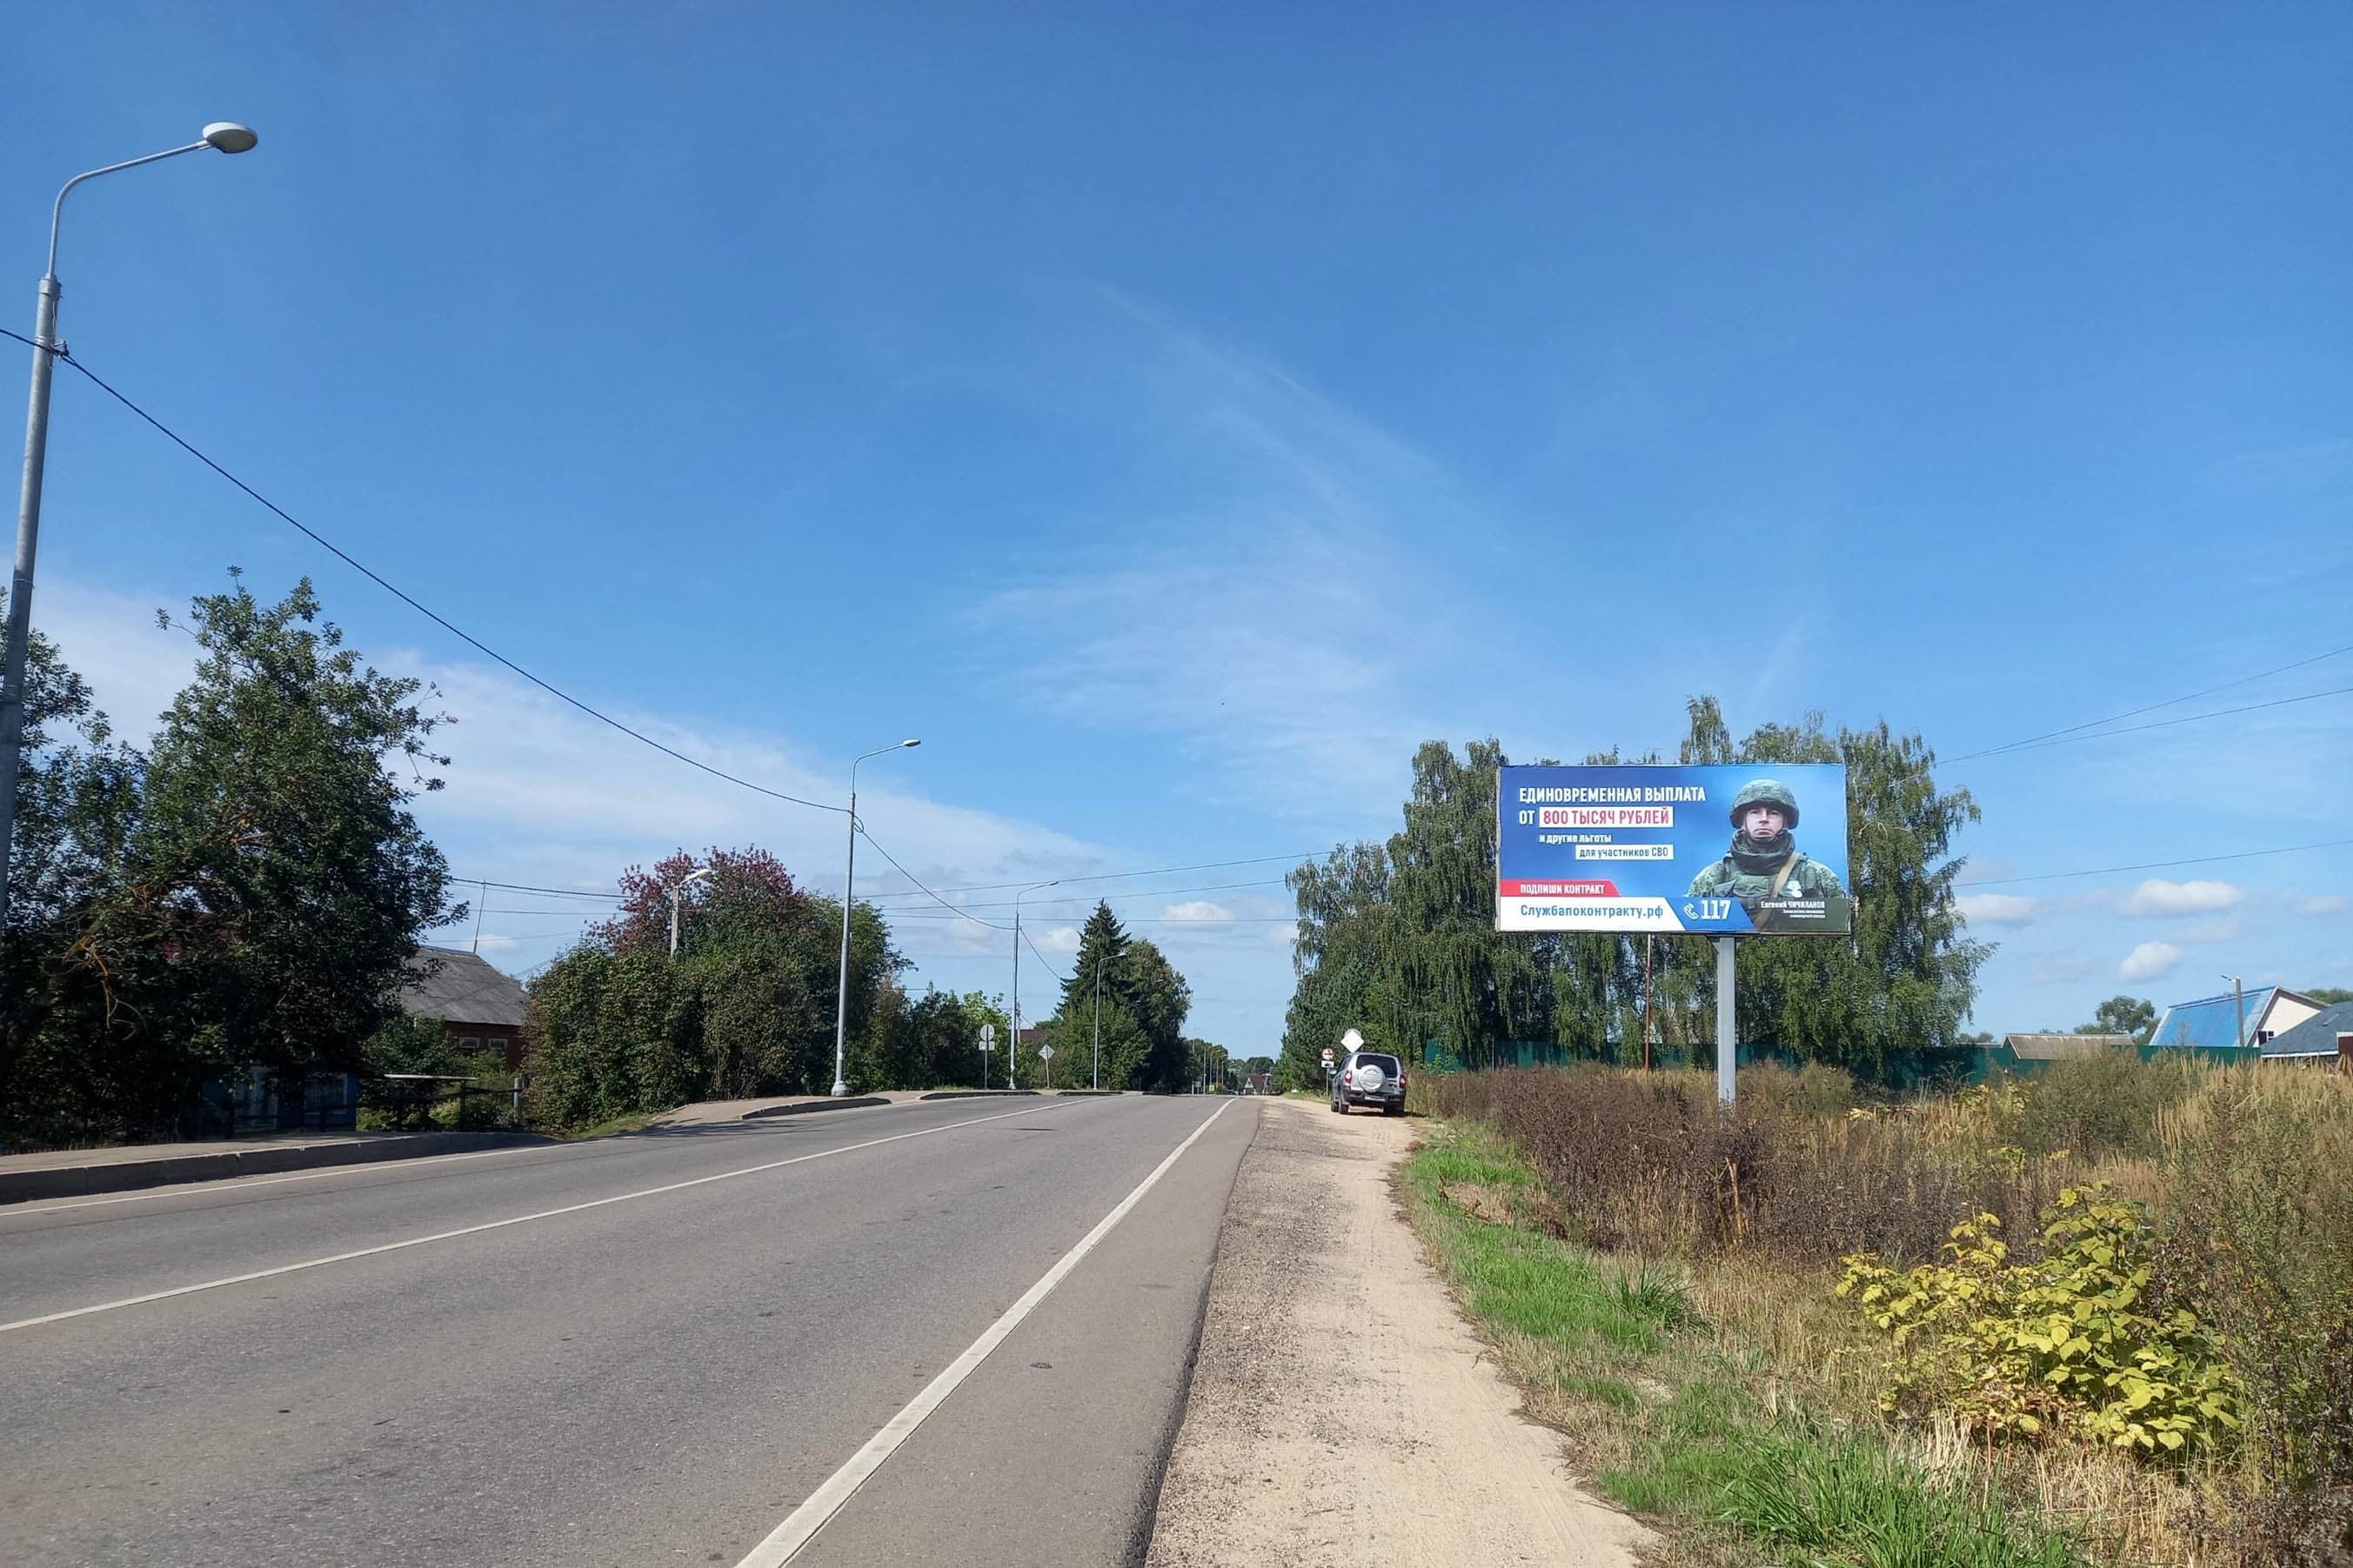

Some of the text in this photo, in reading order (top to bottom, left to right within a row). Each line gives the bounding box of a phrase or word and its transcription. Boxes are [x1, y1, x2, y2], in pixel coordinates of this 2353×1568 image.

[1519, 787, 1706, 803] ЕДИНОВРЕМЕННАЯ ВЫПЛАТА
[1519, 806, 1669, 824] ОТ 800 ТЫСЯЧ РУБЛЕЙ
[1547, 835, 1577, 844] другие
[1580, 847, 1668, 858] для участников СВО
[1521, 884, 1605, 895] ПОДПИШИ КОНТРАКТ
[1521, 904, 1663, 919] Службапоконтракту.рф
[1701, 899, 1732, 919] 117
